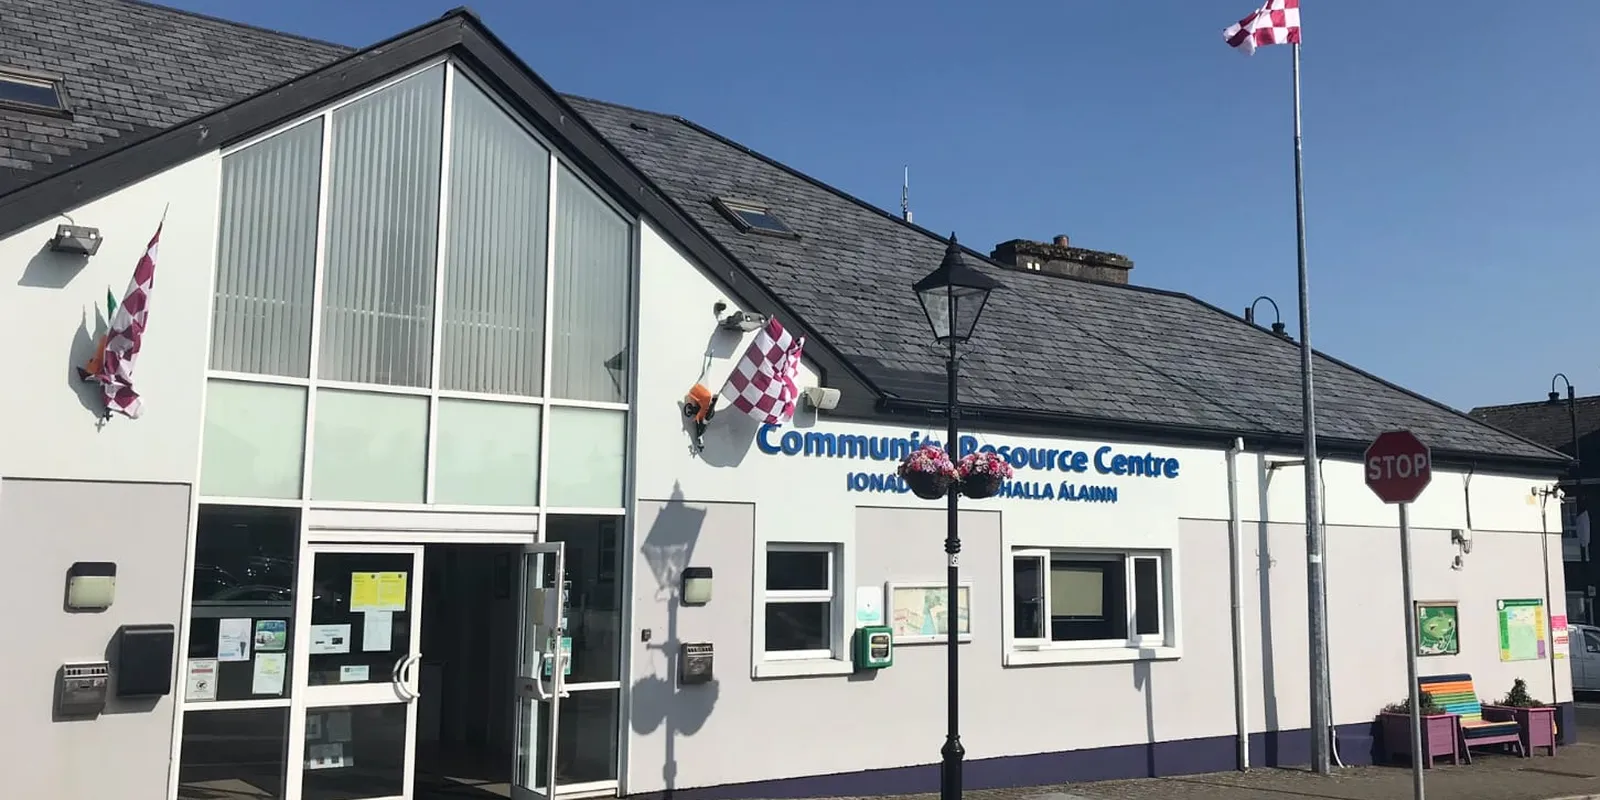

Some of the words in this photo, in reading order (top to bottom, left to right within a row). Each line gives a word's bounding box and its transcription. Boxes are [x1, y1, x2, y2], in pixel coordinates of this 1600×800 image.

[756, 423, 950, 462] Communi
[1094, 446, 1180, 479] Centre
[1369, 453, 1427, 480] STOP
[846, 472, 912, 494] IONAD
[992, 480, 1054, 501] HALLA
[1057, 480, 1118, 503] ÁLAINN
